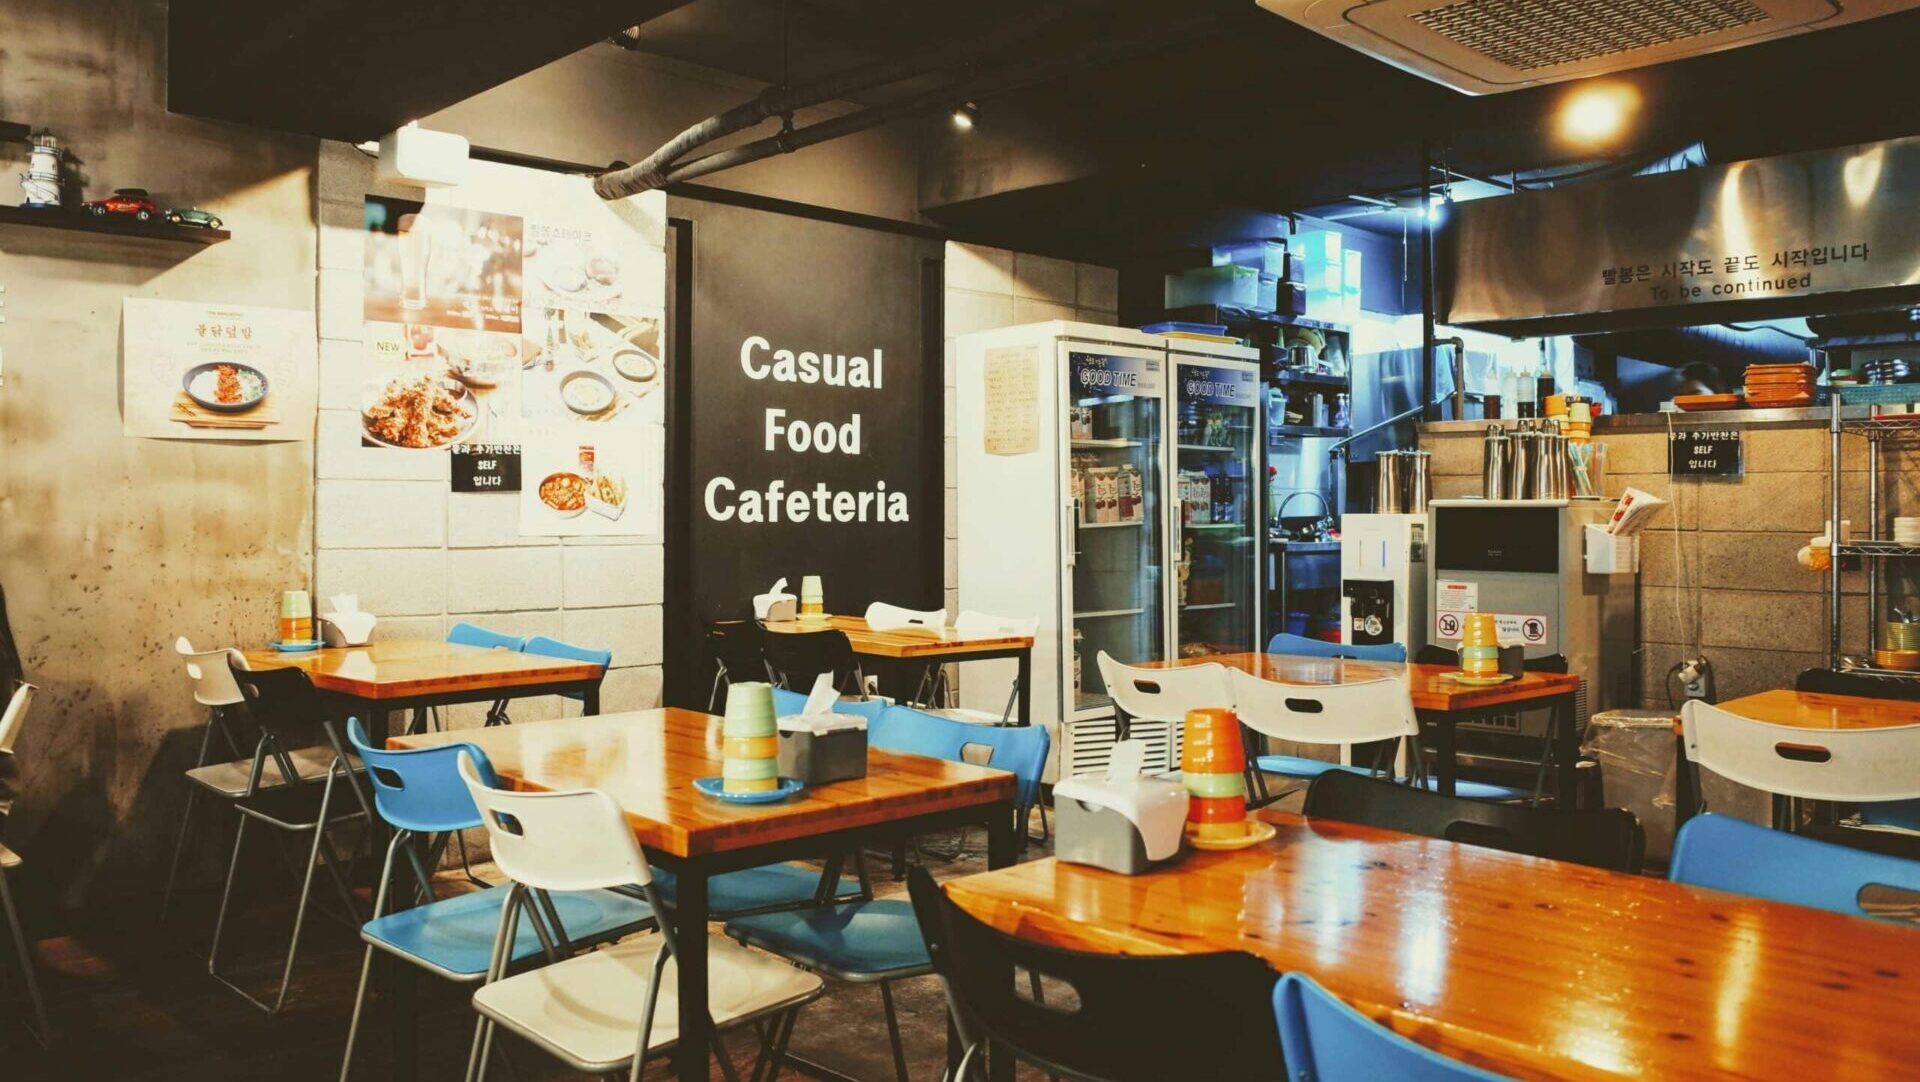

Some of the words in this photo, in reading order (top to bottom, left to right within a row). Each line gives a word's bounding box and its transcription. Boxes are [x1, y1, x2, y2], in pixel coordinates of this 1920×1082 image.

[1602, 264, 1652, 286] 빨봉은
[1661, 259, 1713, 278] 시작도
[1723, 254, 1760, 273] 끝도
[1771, 243, 1869, 268] 시작입니다
[1650, 285, 1669, 301] To
[1680, 283, 1701, 298] be
[1711, 272, 1811, 295] continued
[376, 341, 400, 352] NEW
[740, 335, 882, 389] Casual
[1080, 368, 1112, 387] GOOD
[1112, 370, 1137, 387] TIME
[1187, 380, 1214, 396] GOOD
[1215, 382, 1236, 398] TIME
[765, 408, 860, 455] Food
[1693, 445, 1713, 454] SELF
[477, 460, 497, 470] SELF
[1688, 459, 1717, 469] 입니다
[472, 475, 502, 487] 입니다
[704, 476, 909, 523] Cafeteria
